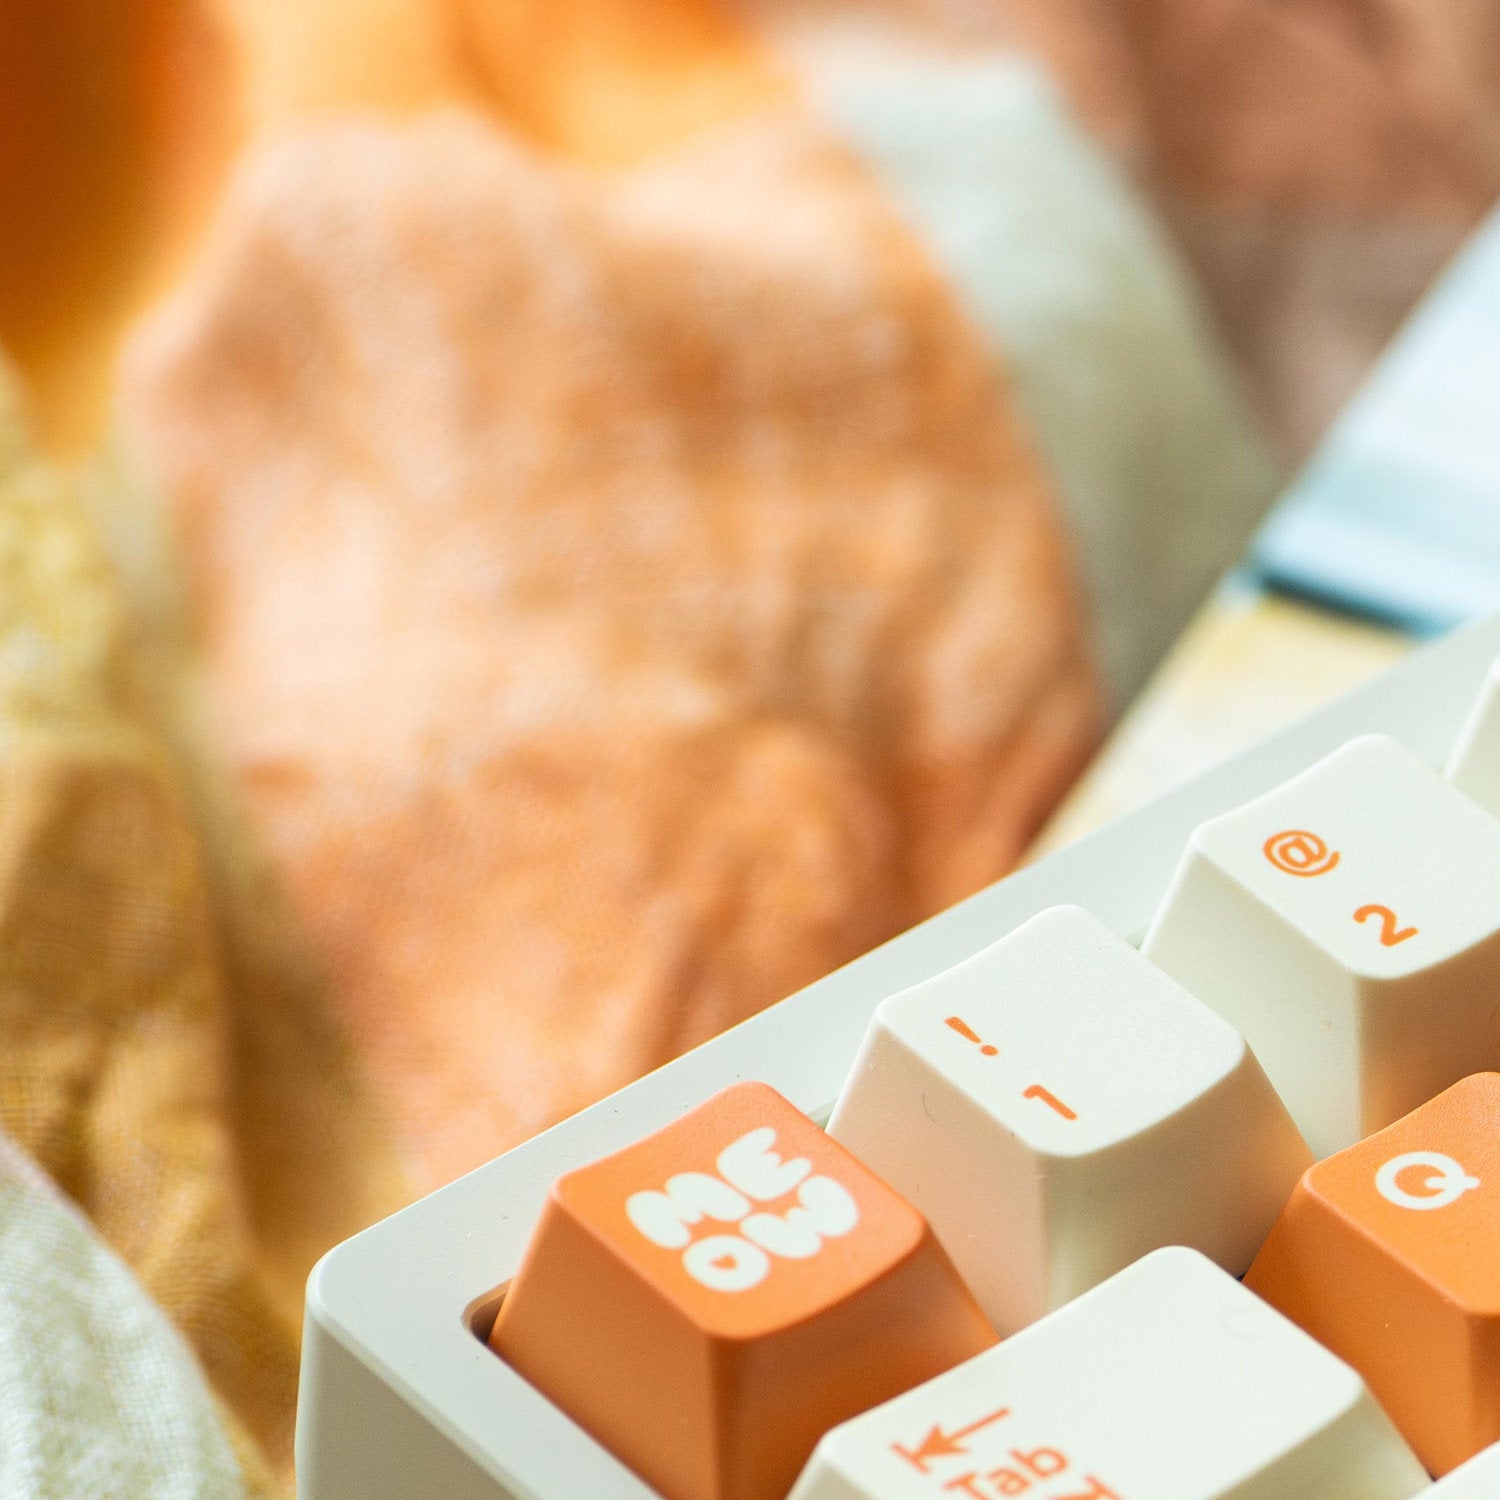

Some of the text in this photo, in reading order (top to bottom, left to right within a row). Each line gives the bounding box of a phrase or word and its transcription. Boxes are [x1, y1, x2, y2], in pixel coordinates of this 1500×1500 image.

[1263, 830, 1341, 878] @
[1353, 904, 1418, 947] 2
[945, 1016, 999, 1057] !
[1023, 1084, 1077, 1121] 1
[1375, 1151, 1481, 1210] Q
